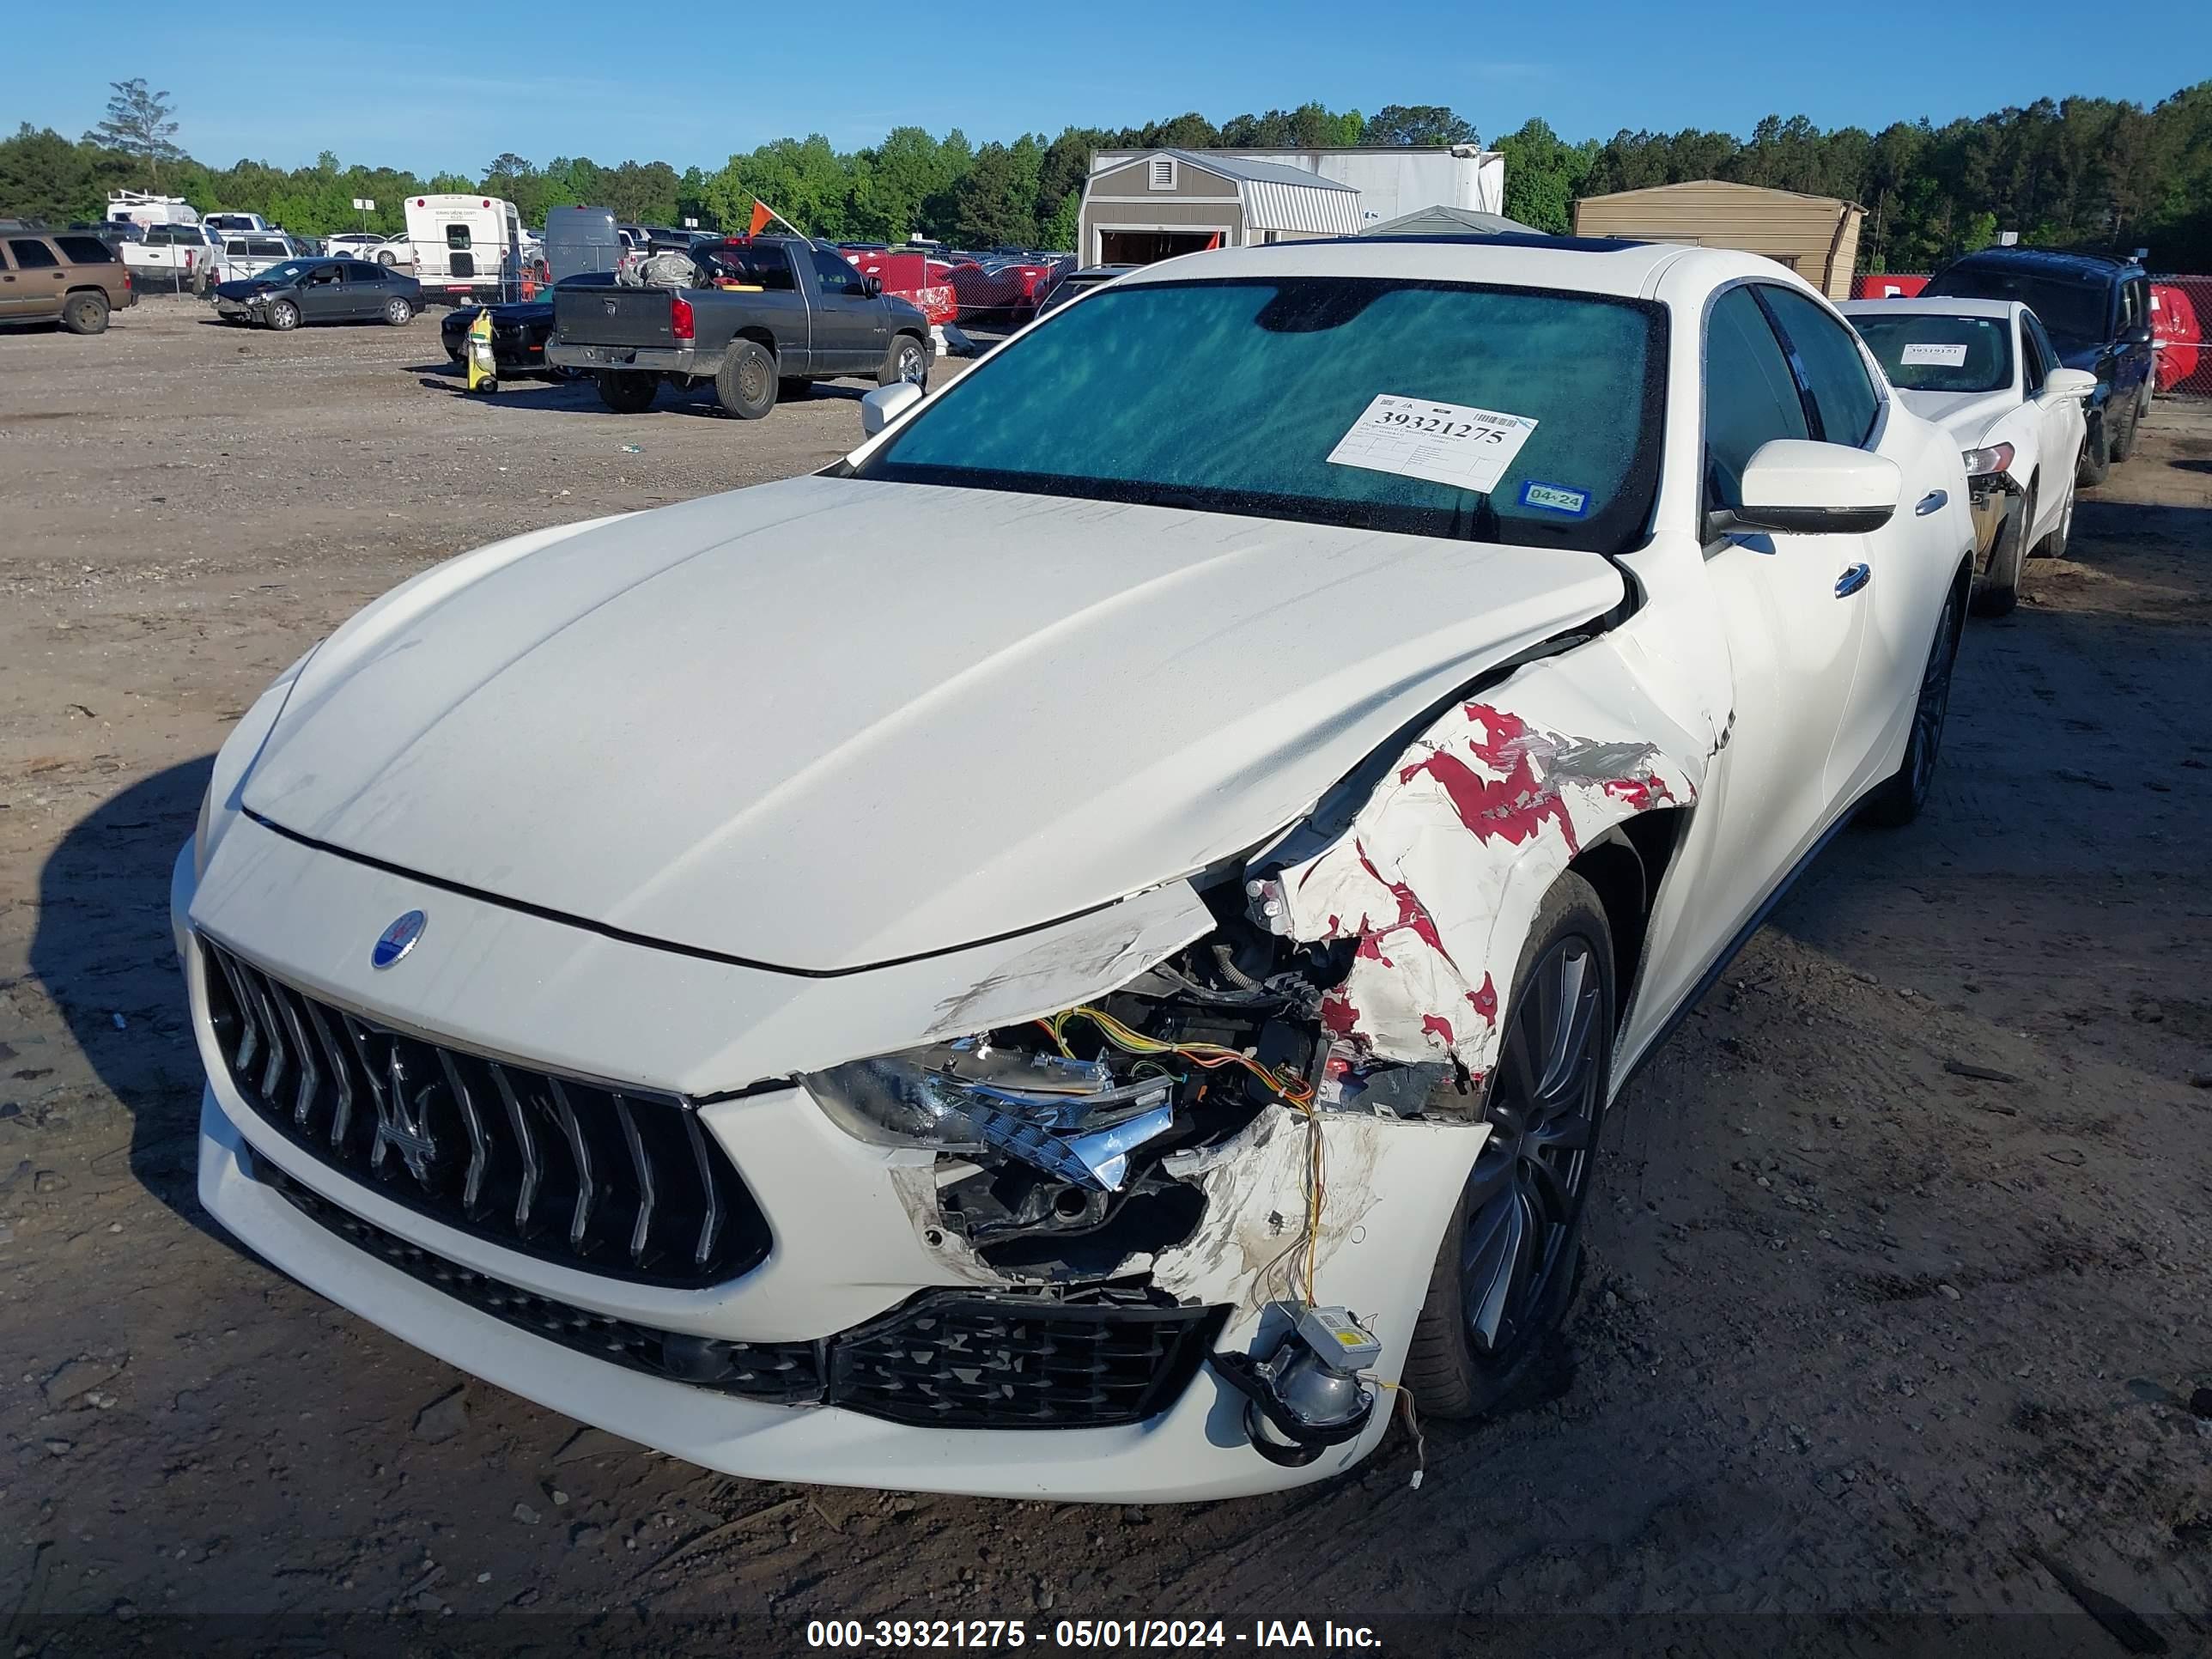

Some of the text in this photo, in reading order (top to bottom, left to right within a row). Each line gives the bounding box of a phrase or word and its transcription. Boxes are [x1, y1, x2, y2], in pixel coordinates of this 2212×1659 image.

[1375, 411, 1507, 444] 39321275
[1400, 428, 1427, 436] Casualty
[1429, 433, 1462, 442] Insurance
